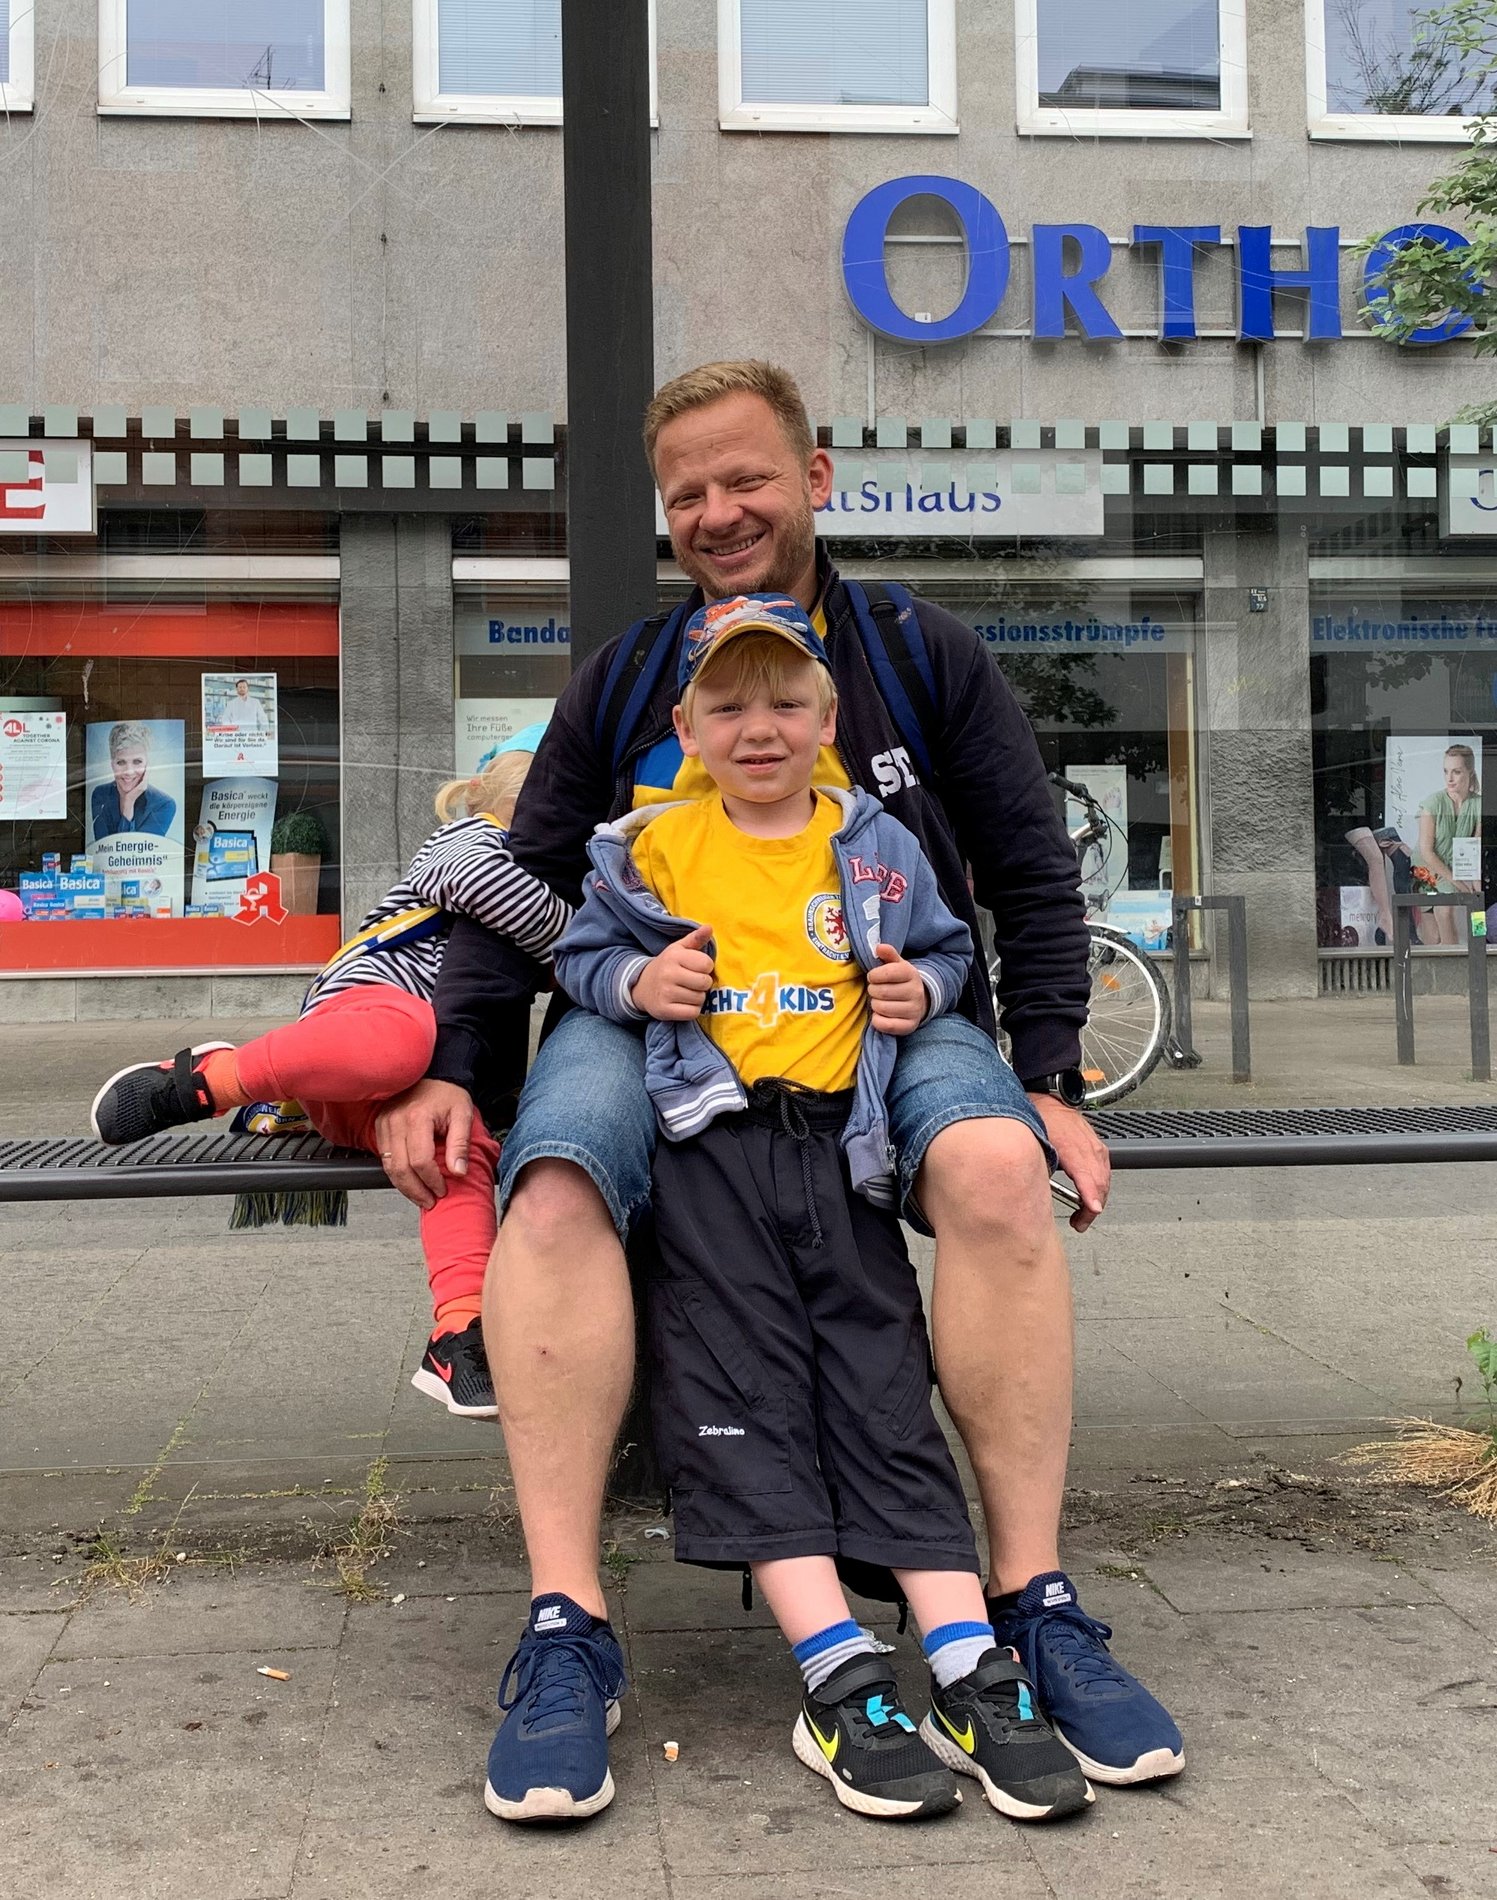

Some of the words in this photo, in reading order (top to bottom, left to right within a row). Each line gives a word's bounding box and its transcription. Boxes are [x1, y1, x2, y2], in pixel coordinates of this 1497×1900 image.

[489, 618, 571, 643] Banda
[1313, 615, 1468, 641] Elektronische
[467, 723, 488, 732] Ihre
[490, 722, 512, 732] Füße
[871, 745, 920, 798] ST
[218, 810, 256, 821] Energie
[116, 840, 158, 853] Energie-
[214, 836, 247, 848] Basica
[22, 880, 53, 890] Basica
[60, 876, 100, 890] Basica
[746, 972, 779, 1028] 4
[780, 987, 834, 1012] KIDS
[698, 1425, 745, 1436] Zebralino
[1046, 1581, 1064, 1597] NIKE
[538, 1606, 561, 1622] NIKE
